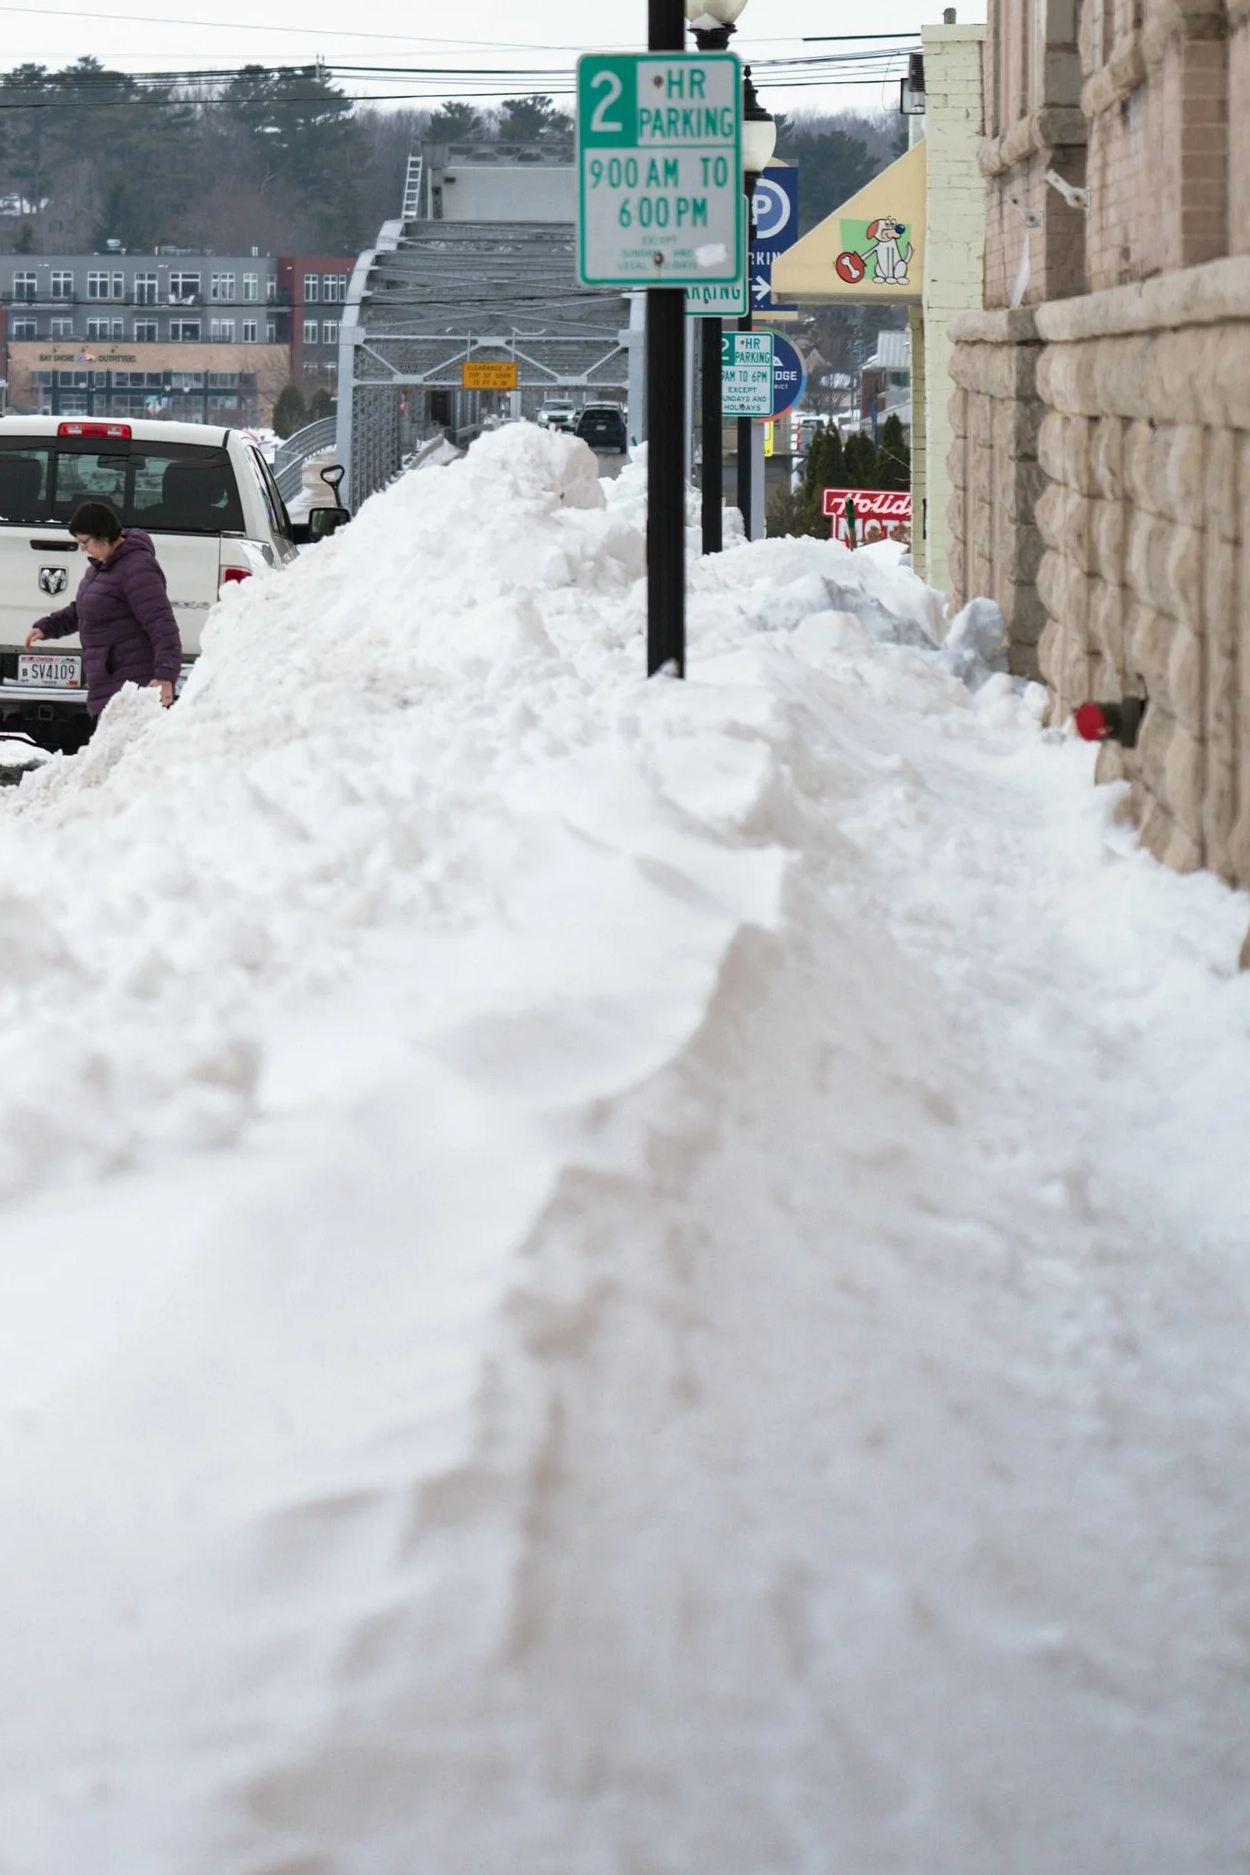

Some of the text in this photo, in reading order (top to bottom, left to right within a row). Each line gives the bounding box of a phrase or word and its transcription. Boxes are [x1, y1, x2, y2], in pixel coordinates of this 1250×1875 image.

[590, 68, 707, 132] 2 HR
[639, 107, 735, 138] PARKING
[646, 157, 679, 188] AM
[700, 156, 728, 188] TO
[676, 197, 708, 228] PM
[745, 338, 761, 349] HR
[39, 354, 51, 362] BAY
[735, 352, 770, 364] PARKING
[739, 370, 748, 382] TO
[751, 371, 768, 383] 6PM
[31, 664, 75, 679] SV4109
